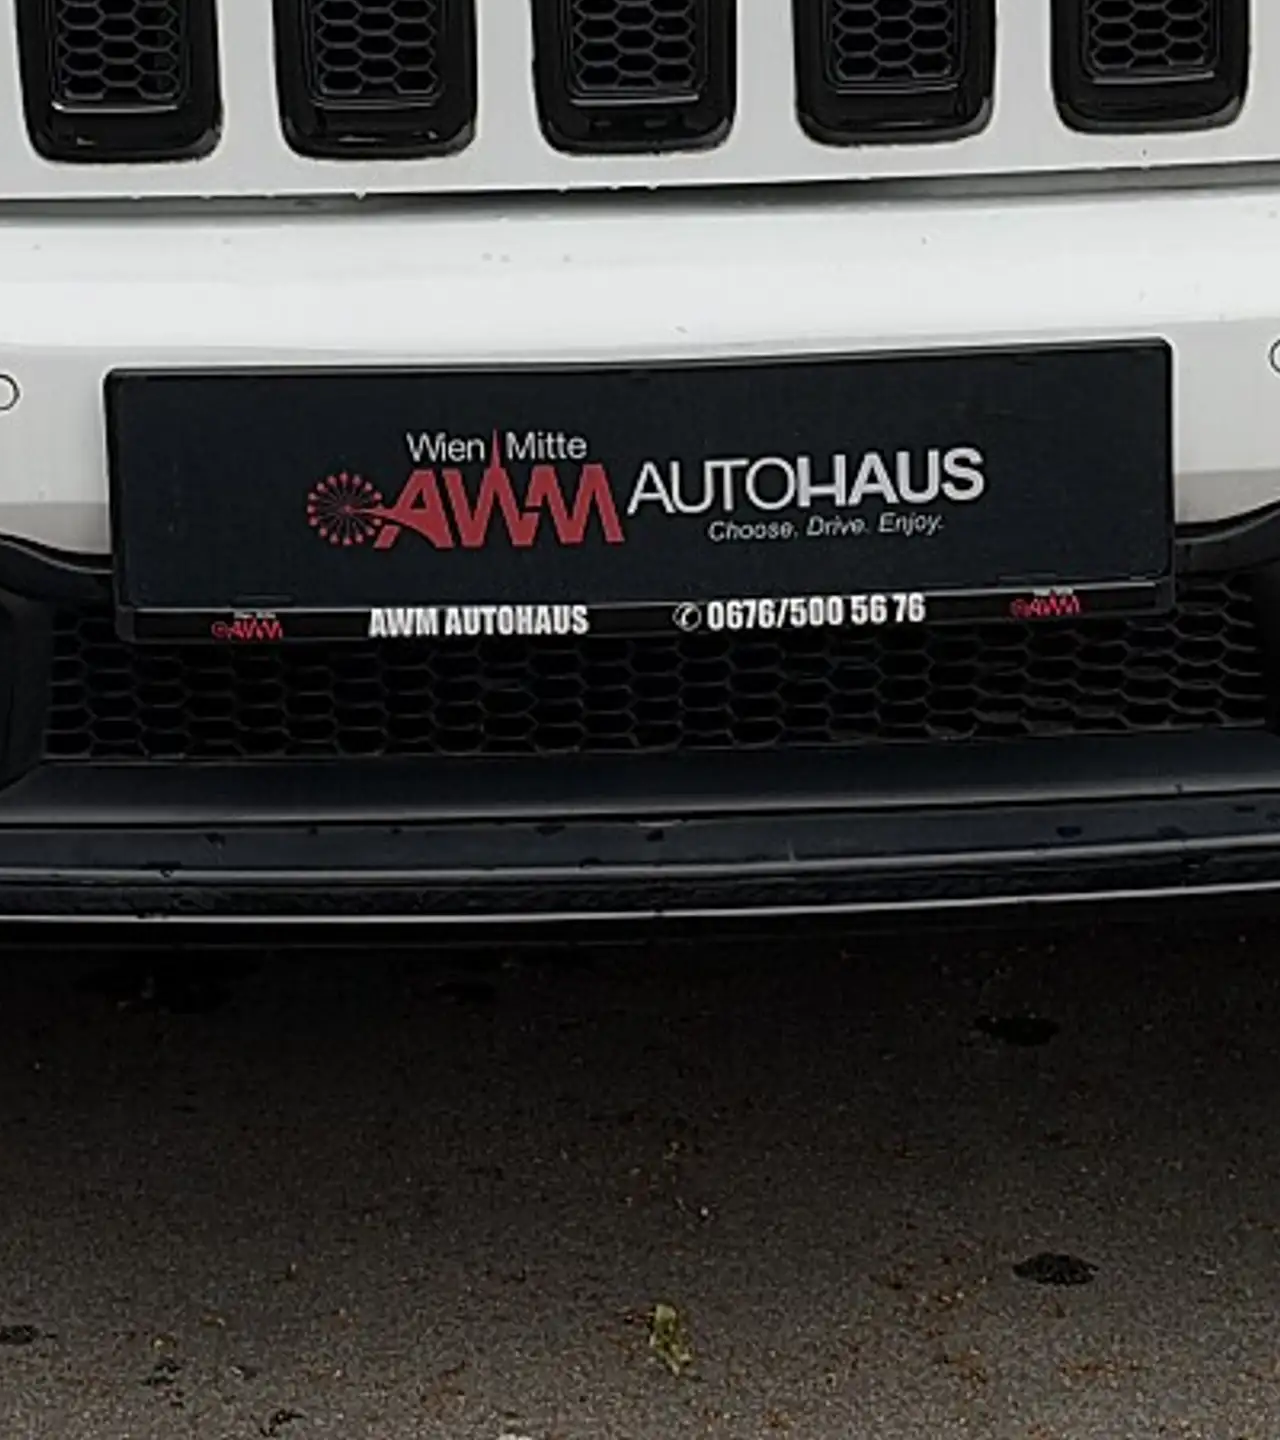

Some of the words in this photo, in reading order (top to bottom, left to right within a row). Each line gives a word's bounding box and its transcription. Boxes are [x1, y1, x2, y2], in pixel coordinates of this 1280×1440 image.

[406, 432, 485, 462] Wien
[505, 431, 588, 460] Mitte
[373, 462, 625, 548] AWM
[626, 447, 985, 515] AUTOHAUS
[708, 520, 798, 543] Choose.
[806, 515, 869, 538] Drive.
[878, 511, 944, 539] Enjoy.
[368, 607, 439, 638] AWM
[444, 604, 590, 636] AUTOHAUS
[707, 595, 844, 631] 0676/500
[850, 593, 888, 626] 56
[892, 591, 926, 623] 76
